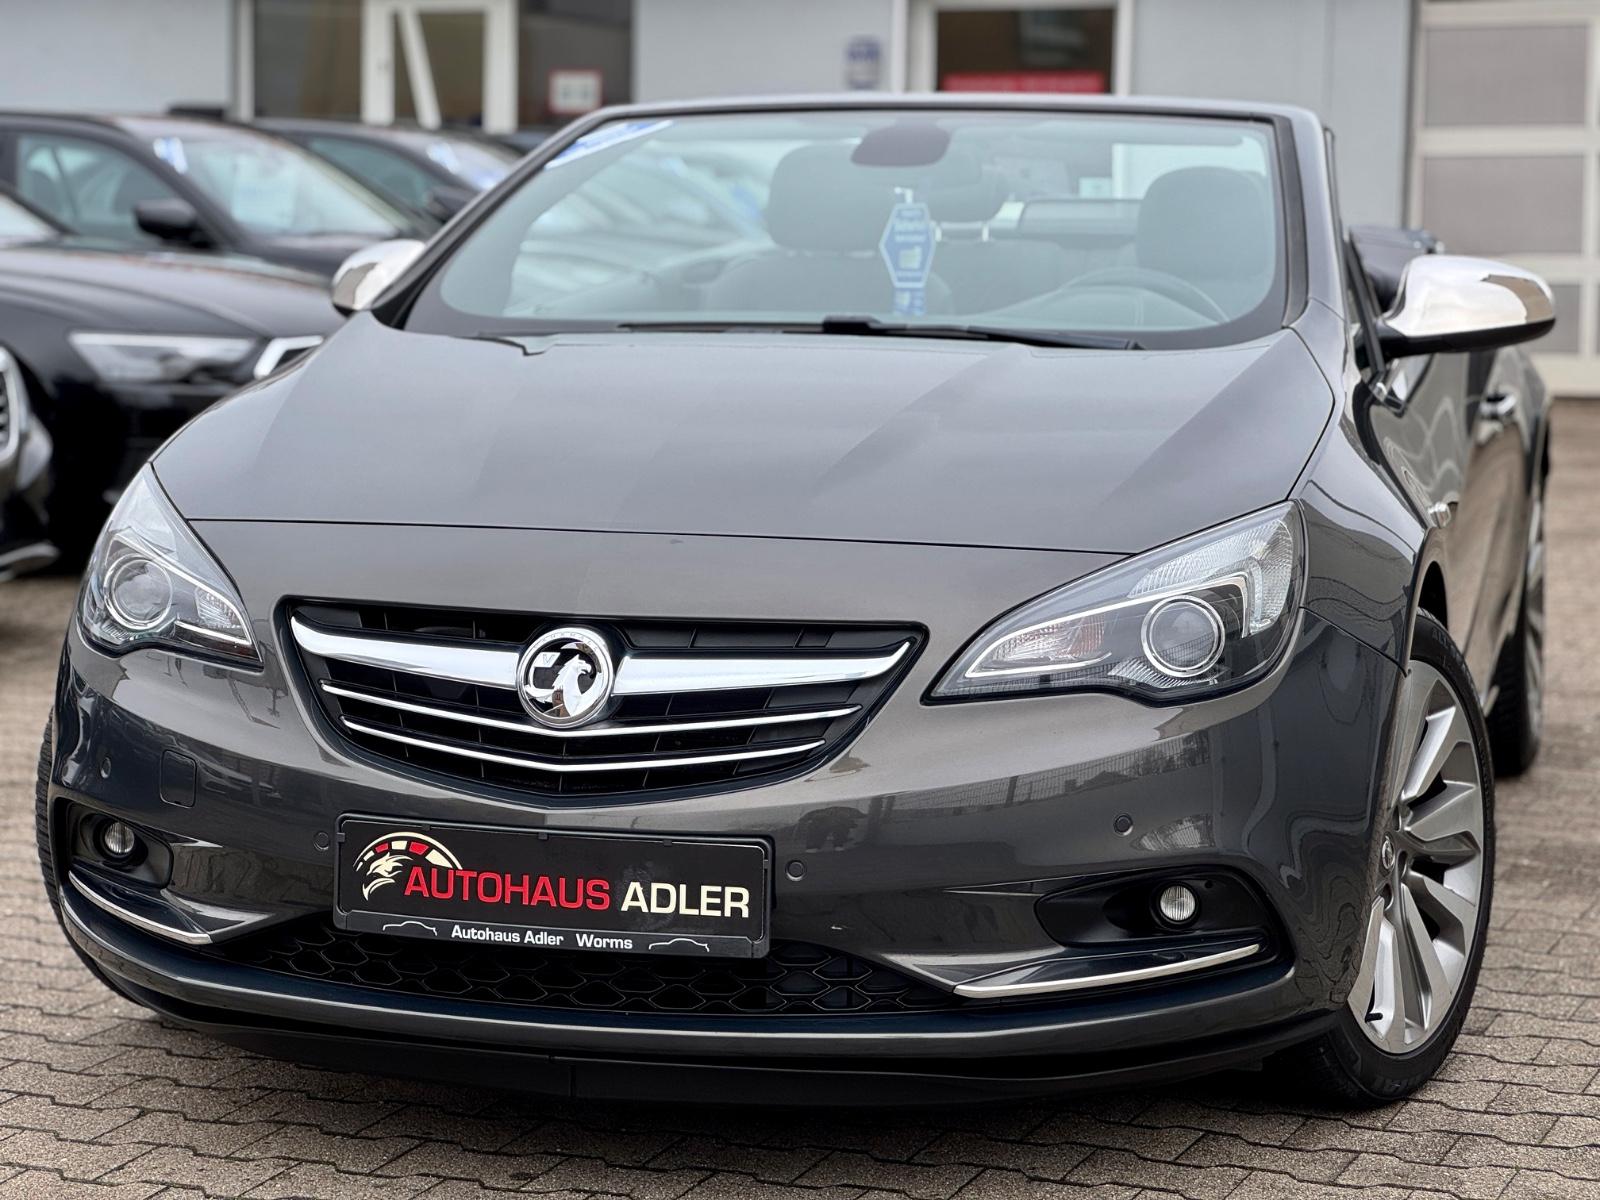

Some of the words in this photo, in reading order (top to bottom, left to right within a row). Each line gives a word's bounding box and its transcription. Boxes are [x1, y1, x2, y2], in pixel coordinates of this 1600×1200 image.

[404, 866, 611, 911] AUTOHAUS
[620, 881, 750, 919] ADLER
[451, 924, 521, 943] Autohaus
[523, 930, 564, 946] Adler
[575, 933, 633, 950] Worms
